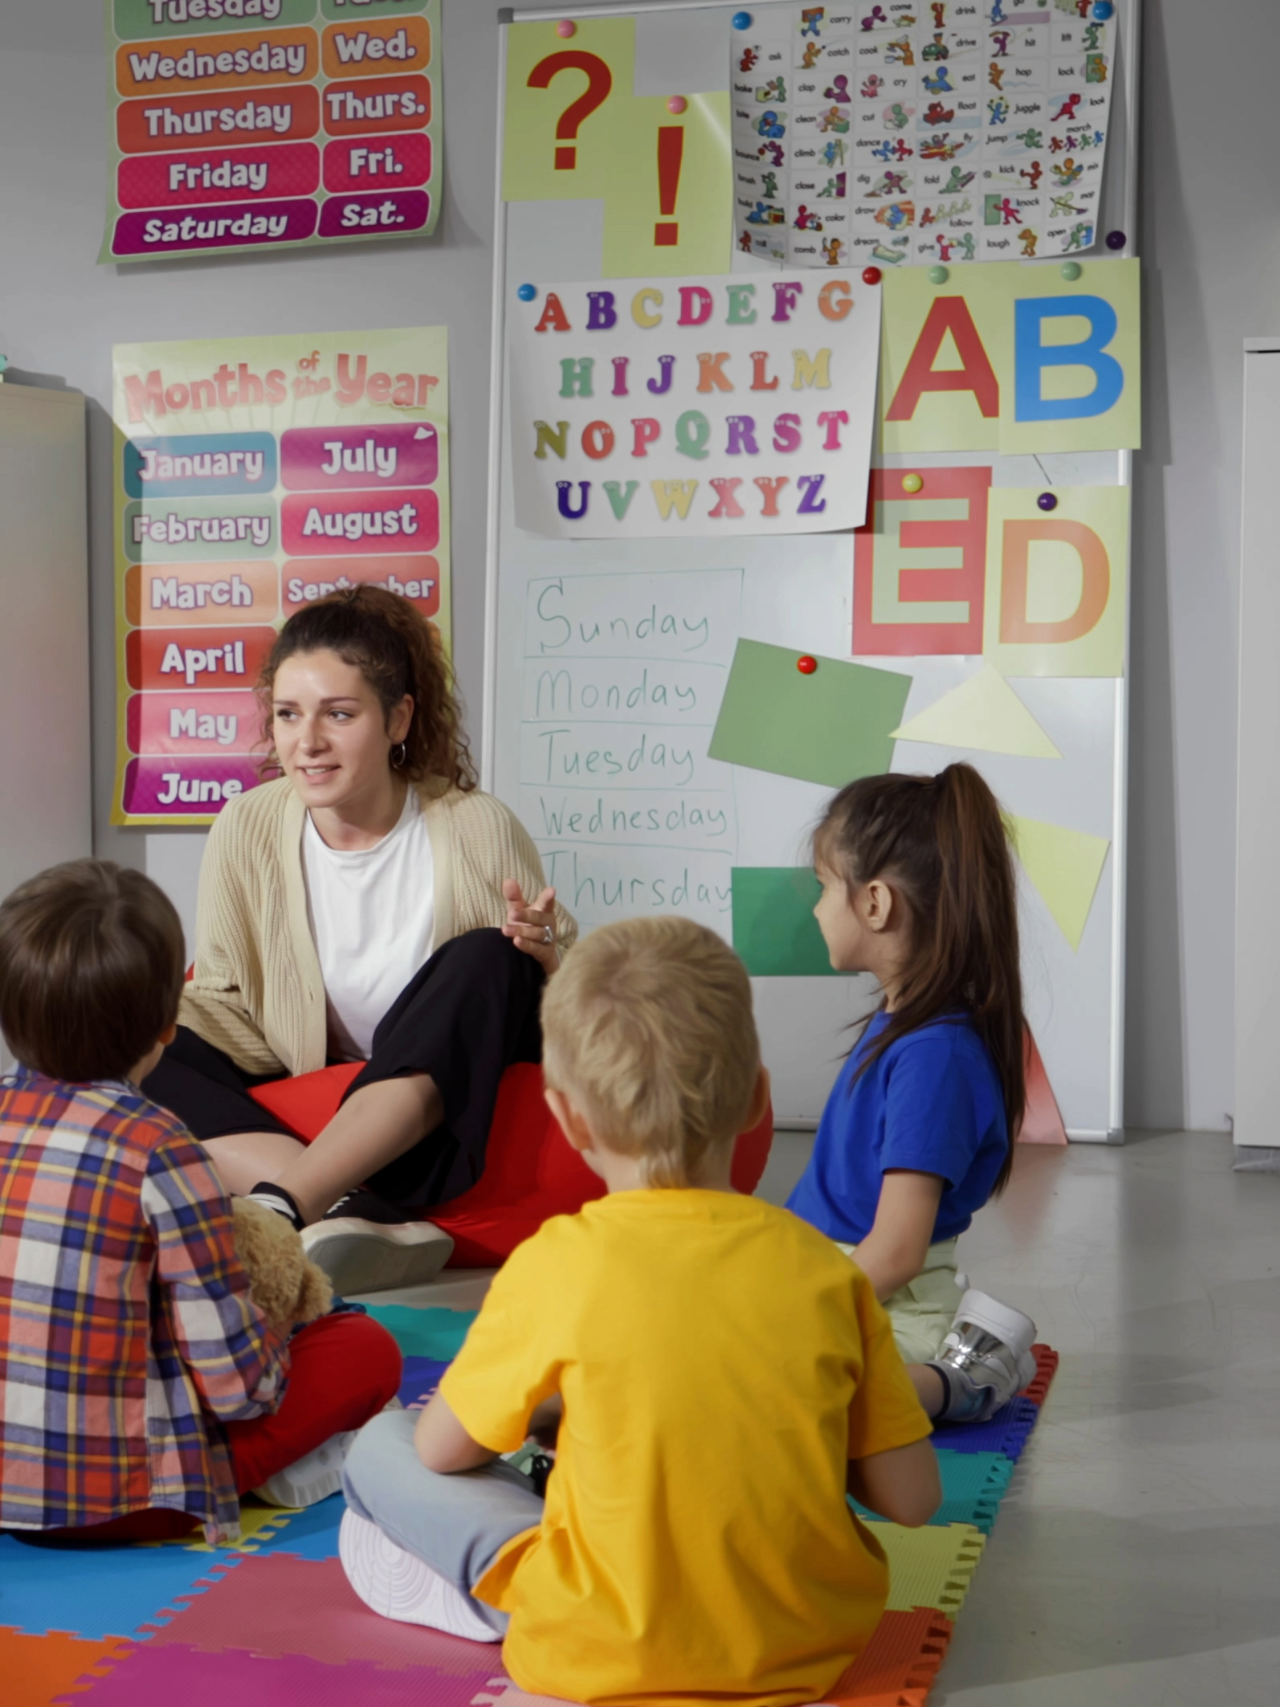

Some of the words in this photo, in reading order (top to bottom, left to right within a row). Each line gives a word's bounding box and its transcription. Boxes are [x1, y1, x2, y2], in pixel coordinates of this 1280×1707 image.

[830, 16, 852, 24] carry
[955, 6, 977, 15] drink
[334, 29, 417, 62] Wed.
[828, 48, 850, 57] catch
[860, 46, 878, 55] cook
[956, 39, 977, 47] drive
[128, 43, 306, 82] Wednesday
[1015, 68, 1032, 77] hop
[798, 84, 815, 93] clap
[893, 79, 907, 87] cry
[962, 74, 975, 82] eat
[144, 101, 292, 136] Thursday
[326, 91, 425, 121] Thurs.
[795, 115, 817, 123] clean
[1014, 103, 1041, 114] juggle
[856, 138, 881, 147] dance
[986, 134, 1008, 145] jump
[168, 160, 268, 191] Friday
[349, 148, 403, 176] Fri.
[999, 165, 1016, 174] kick
[857, 174, 871, 185] dig
[924, 175, 940, 184] fold
[340, 200, 405, 227] Sat.
[855, 206, 876, 215] draw
[1016, 198, 1040, 207] knock
[142, 213, 289, 243] Saturday
[825, 214, 845, 222] color
[949, 219, 974, 227] follow
[854, 237, 880, 246] dream
[918, 244, 935, 253] give
[1047, 229, 1066, 238] open
[534, 293, 572, 333] A
[585, 291, 617, 330] B
[631, 287, 664, 329] C
[677, 286, 713, 326] D
[725, 284, 758, 325] E
[771, 281, 803, 323] F
[817, 280, 854, 321] G
[559, 357, 595, 398] H
[611, 356, 630, 396] I
[647, 355, 676, 395] J
[696, 352, 735, 393] K
[749, 351, 779, 391] L
[790, 348, 832, 390] M
[884, 296, 999, 421] A
[1014, 294, 1126, 422] B
[123, 363, 287, 424] Months
[297, 350, 320, 372] of
[336, 353, 439, 408] Year
[533, 420, 570, 460] N
[581, 420, 615, 460] O
[630, 417, 661, 457] P
[674, 409, 710, 460] Q
[725, 415, 760, 455] R
[772, 413, 802, 453] S
[817, 410, 849, 451] T
[137, 449, 264, 481] January
[321, 439, 397, 478] July
[556, 480, 592, 520] U
[602, 480, 640, 521] V
[650, 479, 698, 520] W
[708, 477, 745, 518] X
[753, 476, 790, 517] Y
[796, 474, 826, 514] Z
[133, 513, 271, 546] February
[302, 503, 418, 540] August
[871, 498, 970, 624] E
[151, 574, 253, 611] March
[998, 519, 1110, 644] D
[537, 578, 709, 653] Sunday
[160, 640, 245, 685] April
[536, 668, 697, 717] Monday
[169, 708, 237, 745] May
[538, 729, 695, 785] Tuesday
[157, 772, 243, 805] June
[539, 797, 727, 836] Wednesday
